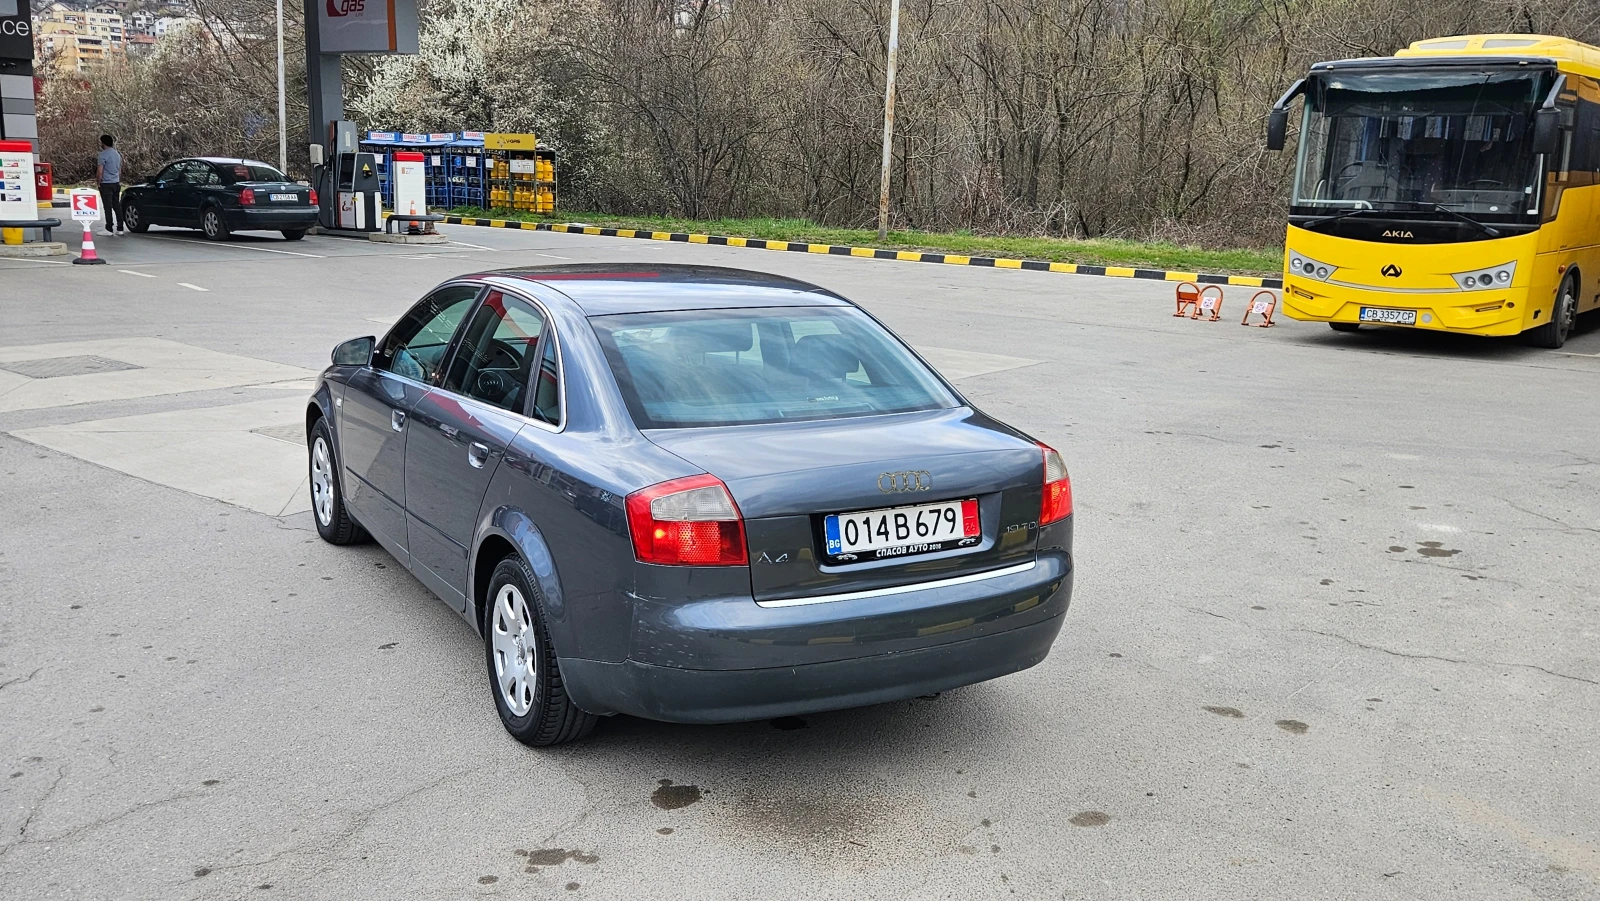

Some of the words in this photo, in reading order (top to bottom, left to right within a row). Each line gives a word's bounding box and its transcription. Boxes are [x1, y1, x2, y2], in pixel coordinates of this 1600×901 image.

[0, 20, 29, 36] ce
[1381, 229, 1414, 239] AKIA
[829, 539, 840, 549] BG
[876, 545, 907, 557] СПАСОВ
[908, 543, 928, 553] АУТО
